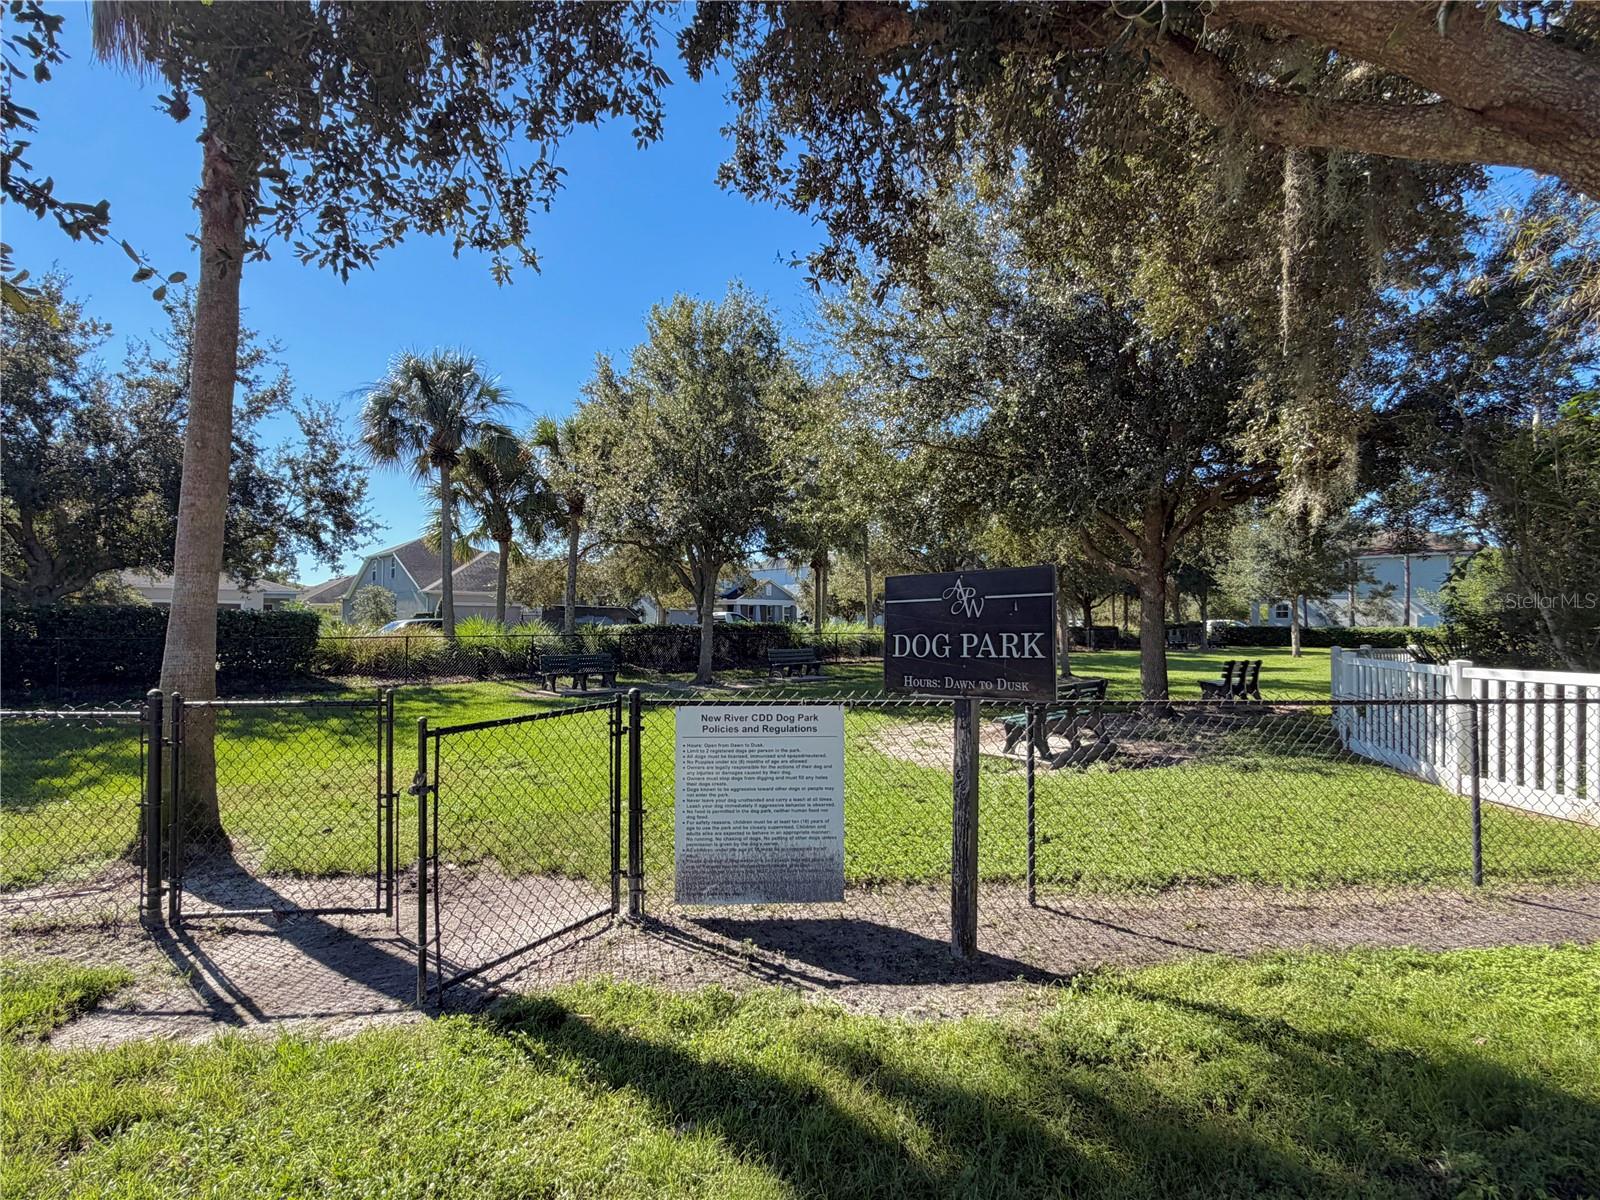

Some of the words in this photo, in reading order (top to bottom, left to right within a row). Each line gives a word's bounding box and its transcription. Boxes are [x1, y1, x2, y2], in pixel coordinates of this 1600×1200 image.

[892, 633, 952, 658] DOG
[959, 632, 1046, 659] PARK
[701, 714, 721, 722] New
[724, 714, 748, 722] River
[751, 713, 773, 722] CDD
[776, 713, 795, 724] Dog
[797, 713, 819, 722] Park
[702, 725, 739, 733] Policies
[742, 724, 759, 733] and
[762, 724, 818, 735] Regulations
